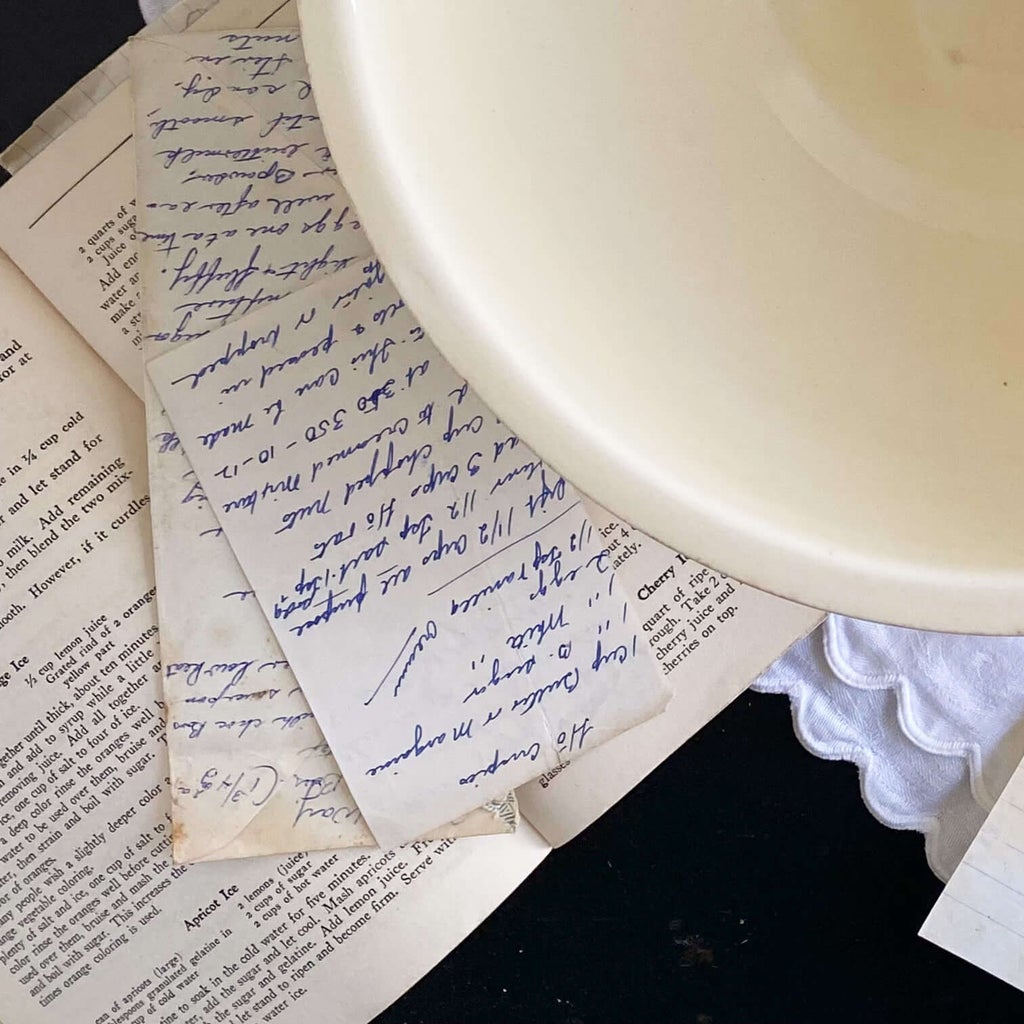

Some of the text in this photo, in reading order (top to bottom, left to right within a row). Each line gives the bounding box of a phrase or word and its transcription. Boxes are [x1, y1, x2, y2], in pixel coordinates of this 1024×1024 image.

[9, 465, 22, 476] in
[40, 434, 59, 450] cup
[62, 411, 84, 432] cold
[6, 457, 125, 559] milk. Add remaining
[28, 494, 151, 599] However, if it curdles
[637, 565, 675, 601] Cherry
[642, 568, 709, 632] quart of ripe
[38, 661, 54, 676] cup
[54, 637, 83, 660] lemon
[82, 615, 108, 638] juice
[45, 620, 121, 684] Grated rind of 2
[656, 582, 735, 661] cherry juice and
[701, 606, 738, 638] on top.
[63, 641, 116, 690] yellow part
[184, 885, 239, 932] Apricot Ice
[262, 904, 282, 921] cups
[283, 890, 294, 904] of
[293, 878, 311, 893] hot
[311, 854, 339, 878] water
